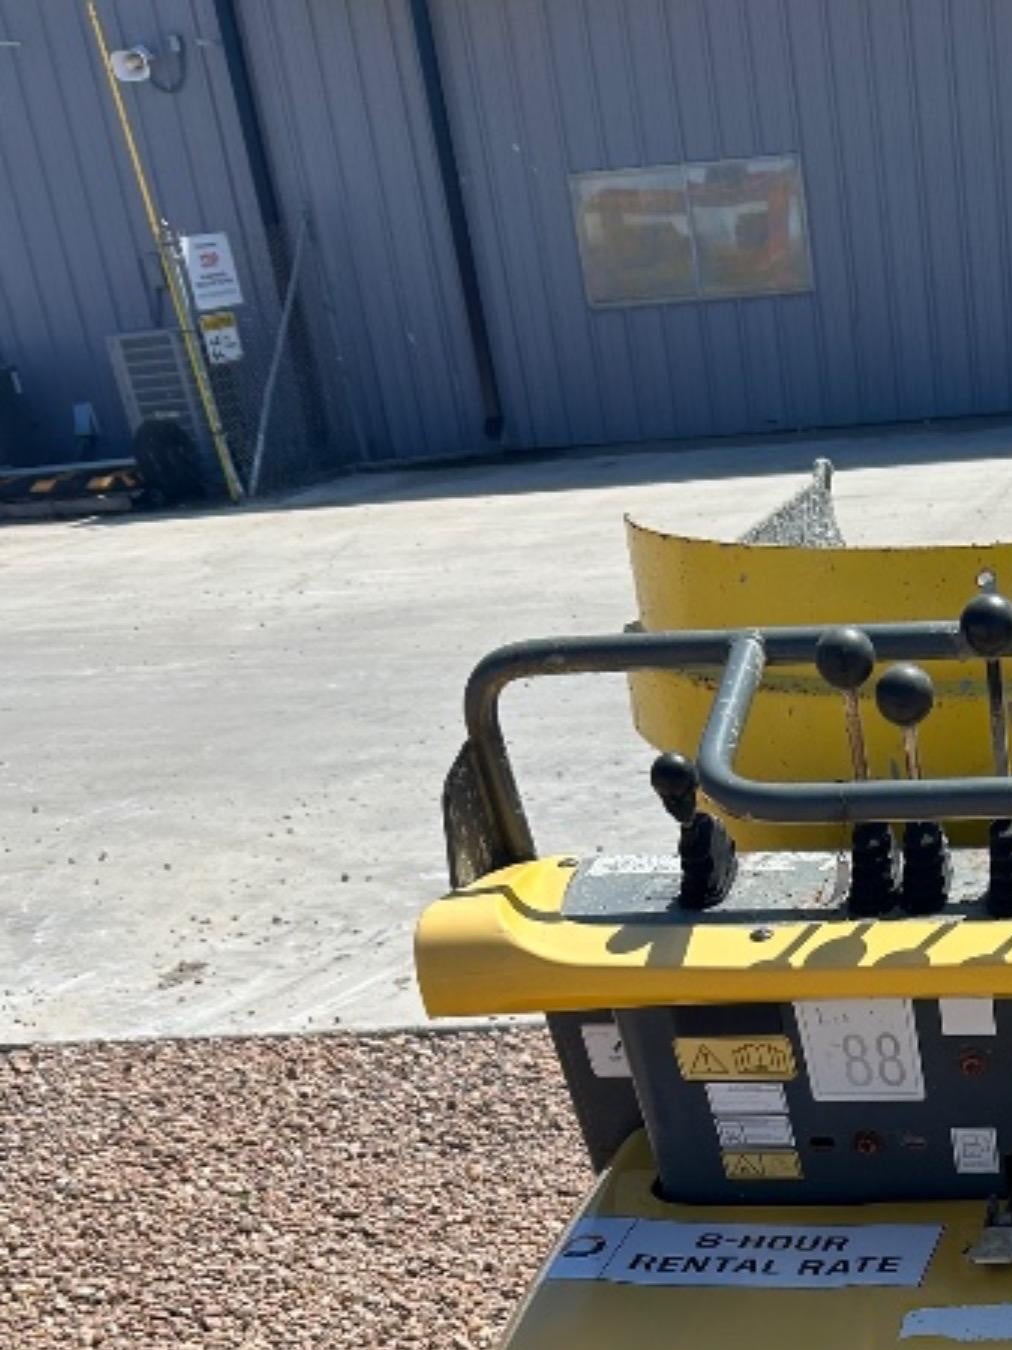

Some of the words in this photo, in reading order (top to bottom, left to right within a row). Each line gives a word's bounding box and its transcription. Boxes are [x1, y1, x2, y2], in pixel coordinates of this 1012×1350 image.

[695, 1232, 851, 1253] 8-HOUR
[628, 1253, 780, 1276] RENTAL
[796, 1255, 902, 1276] RATE
